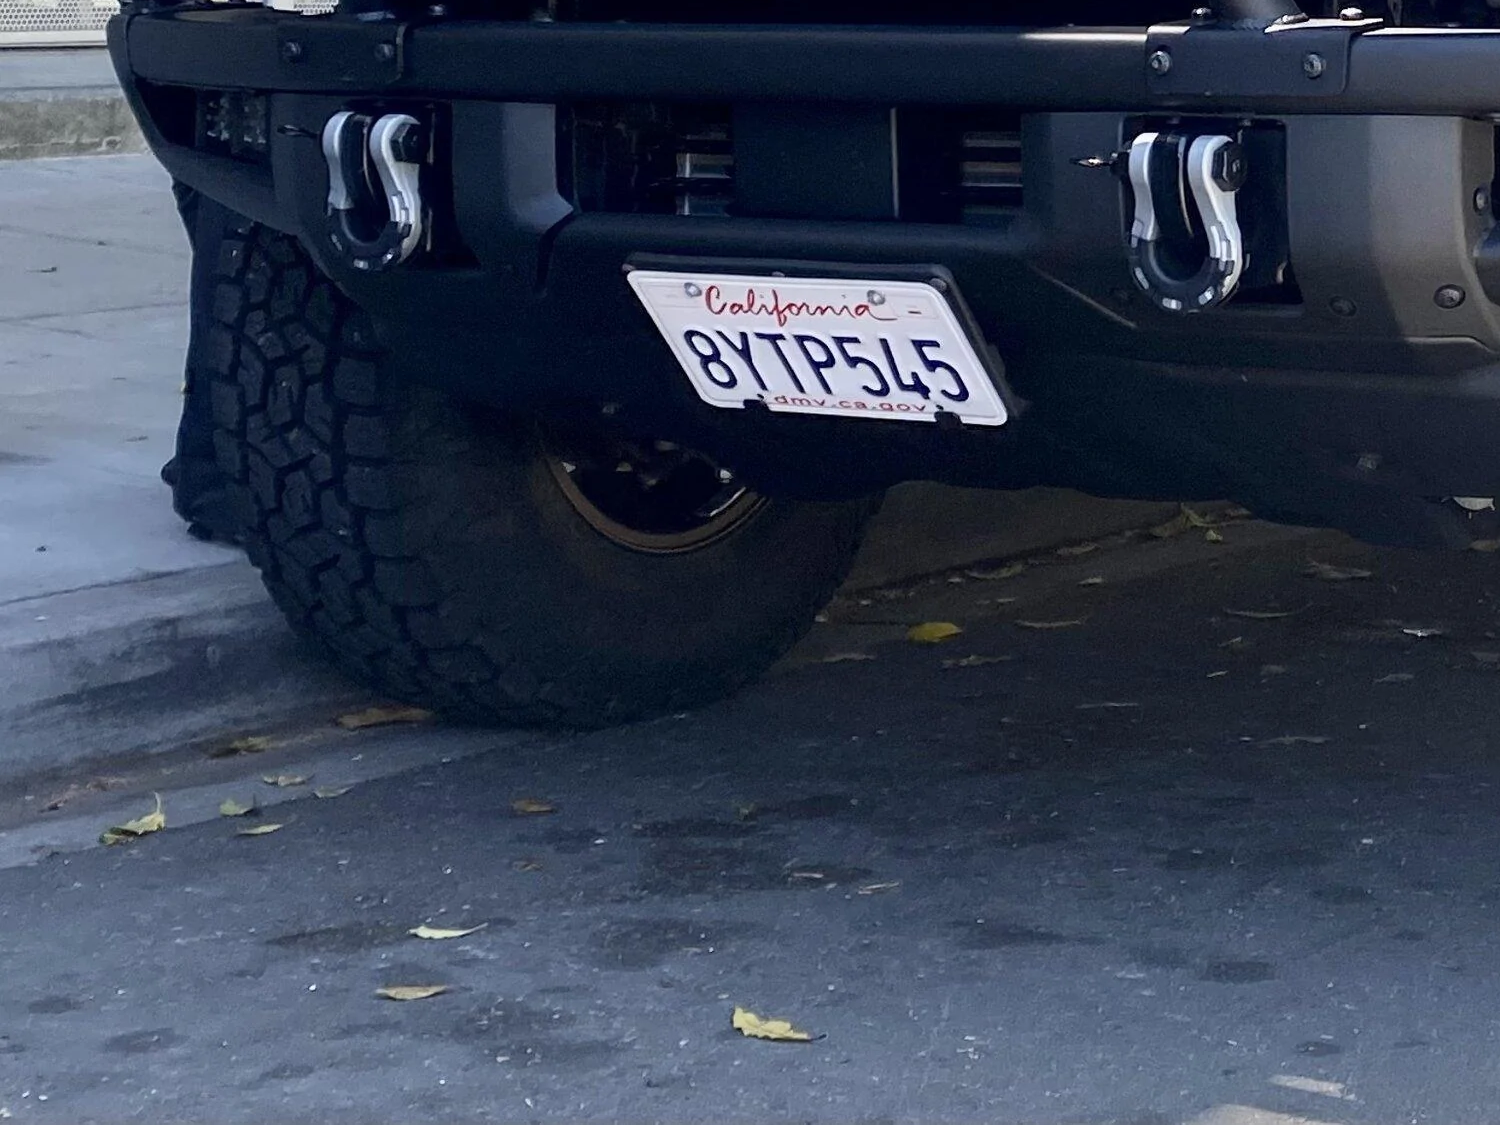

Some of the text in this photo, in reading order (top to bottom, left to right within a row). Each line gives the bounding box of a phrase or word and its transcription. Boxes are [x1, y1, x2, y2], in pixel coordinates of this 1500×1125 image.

[704, 284, 897, 327] California
[683, 329, 970, 402] 8YTP545
[774, 395, 927, 413] dmv.ca.gov
